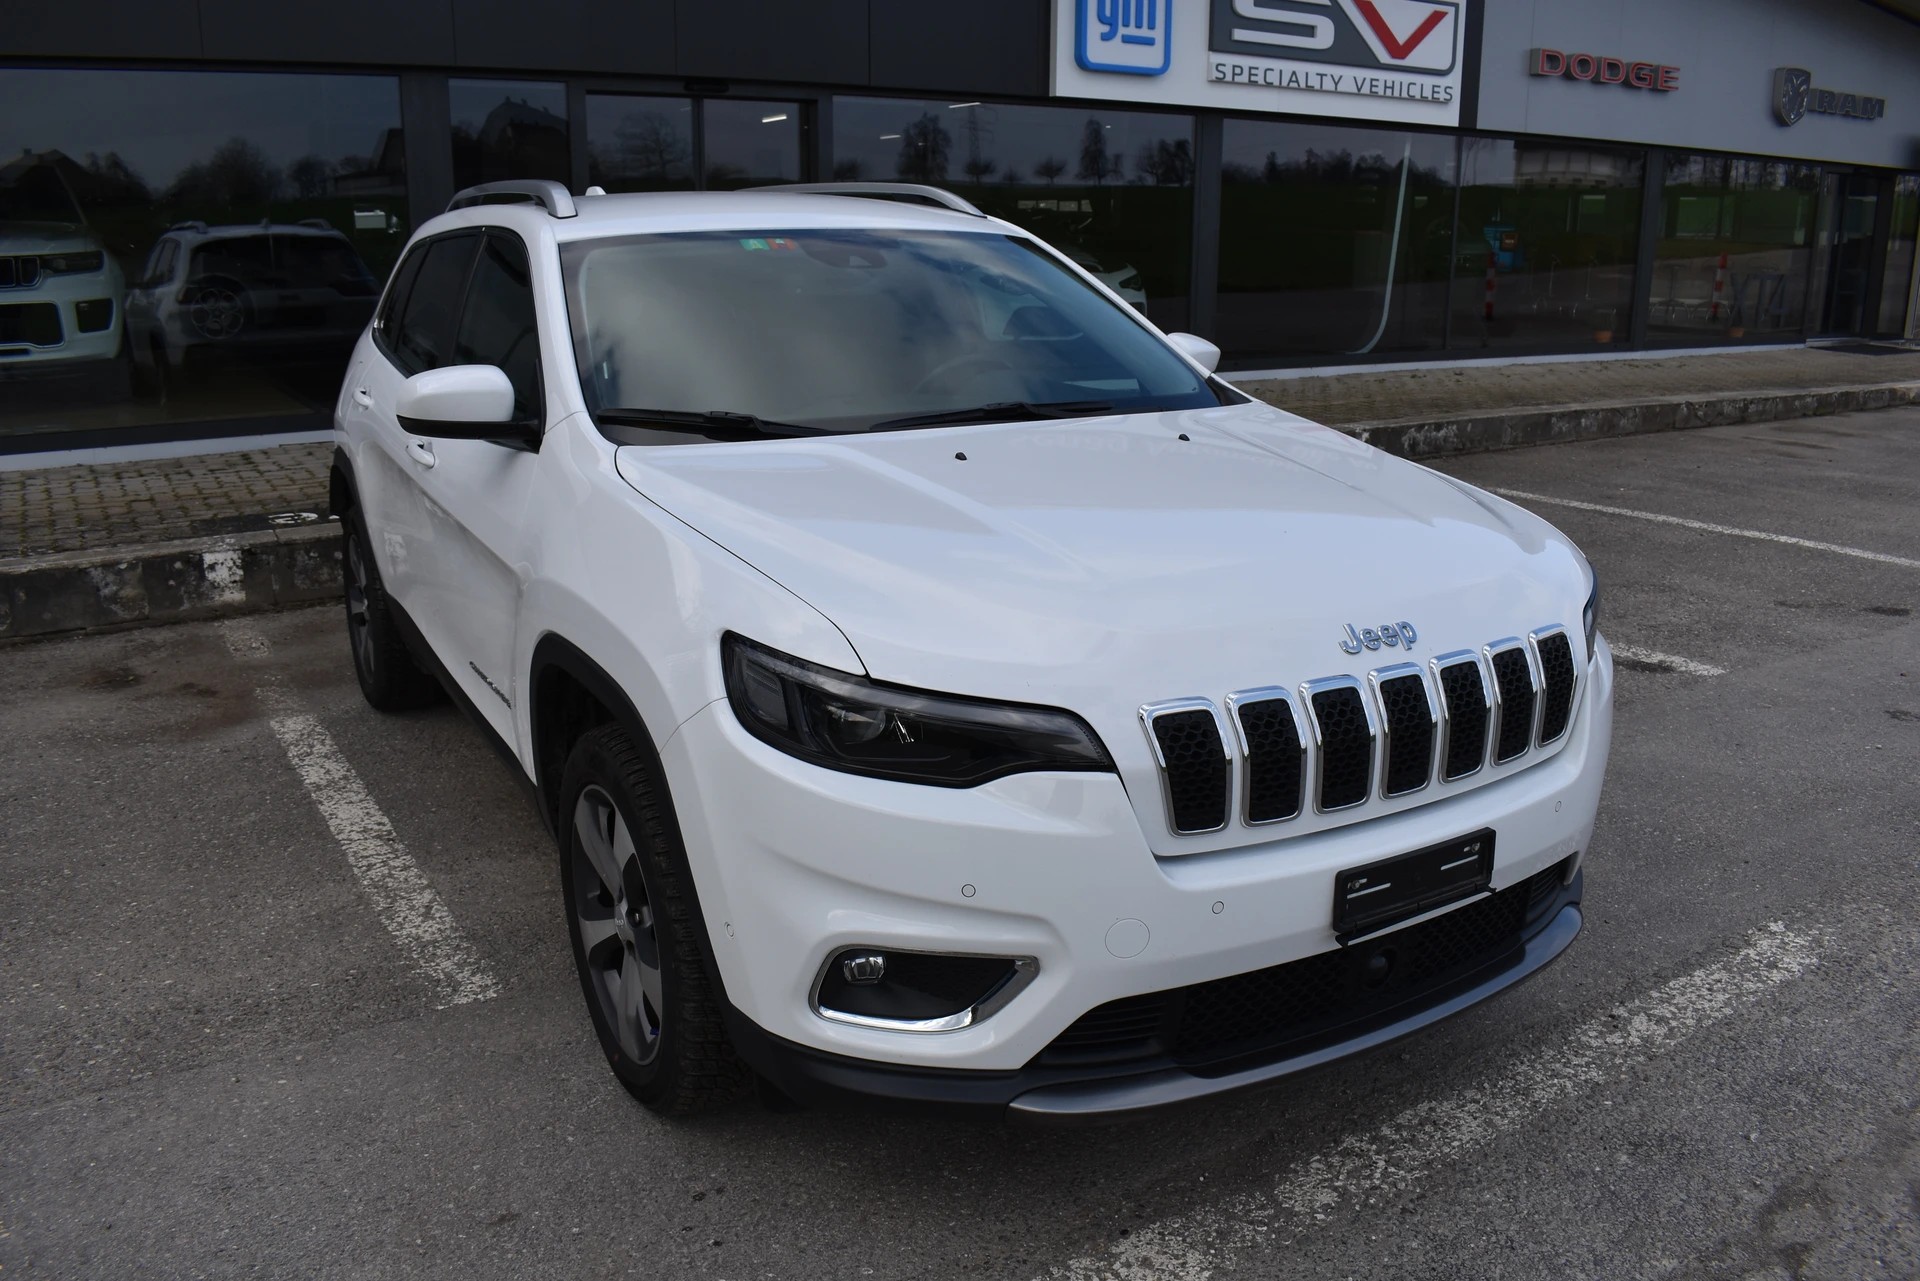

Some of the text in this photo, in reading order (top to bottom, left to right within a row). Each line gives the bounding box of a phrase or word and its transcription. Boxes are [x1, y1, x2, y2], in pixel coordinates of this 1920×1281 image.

[1214, 62, 1454, 102] SPECIALTY VEHICLES
[1536, 48, 1681, 92] DODGE
[1813, 88, 1886, 119] RAM
[1338, 621, 1418, 655] Jeep
